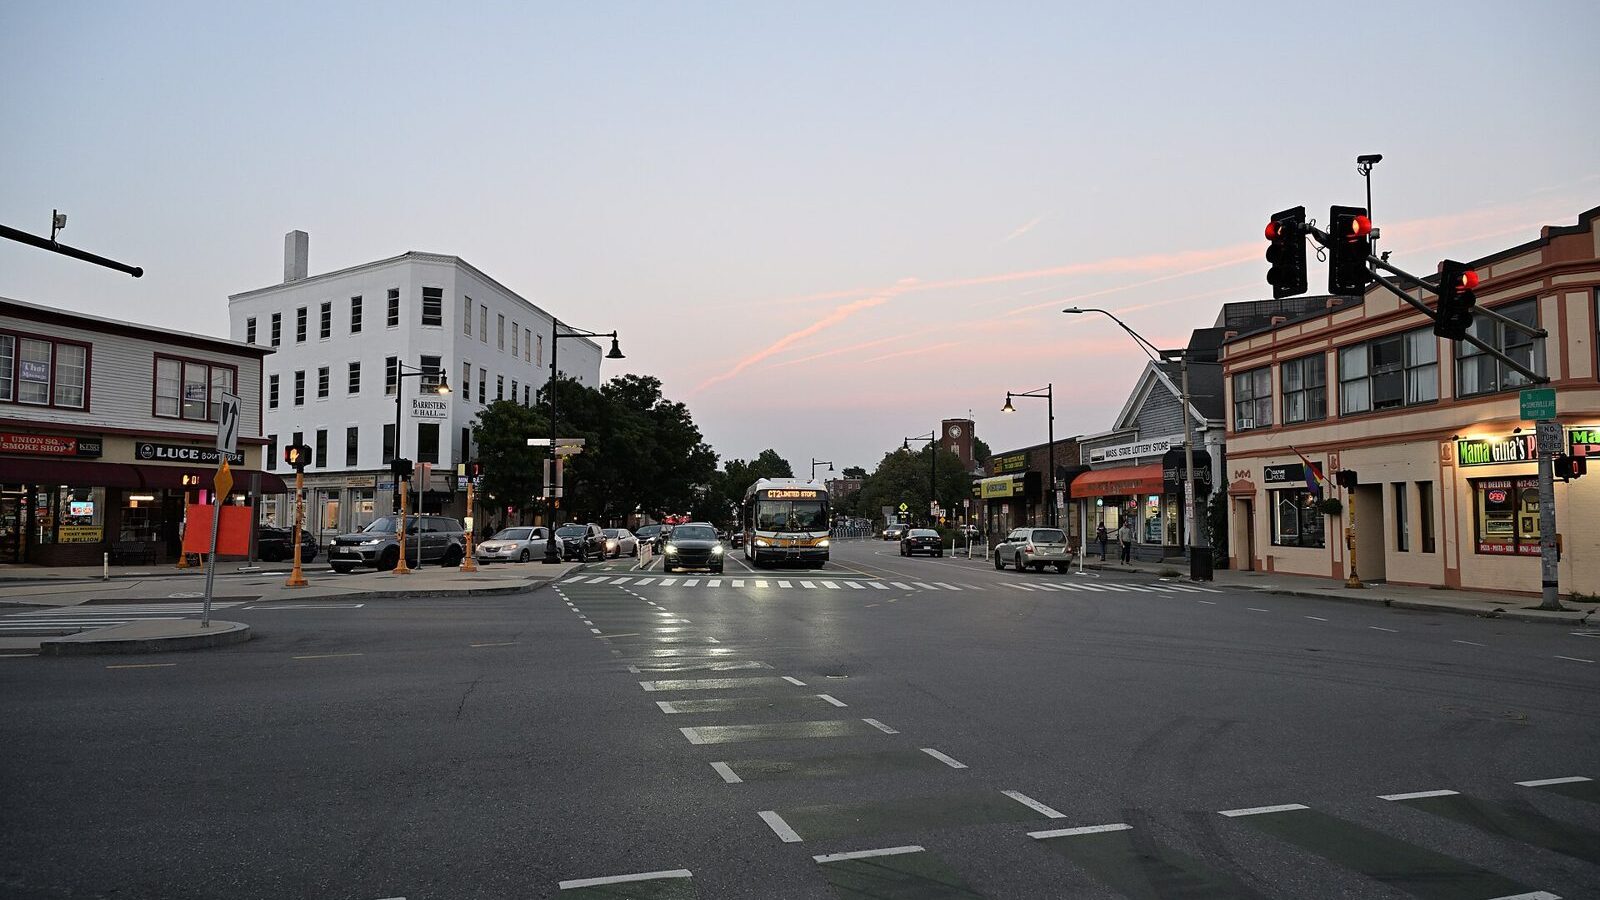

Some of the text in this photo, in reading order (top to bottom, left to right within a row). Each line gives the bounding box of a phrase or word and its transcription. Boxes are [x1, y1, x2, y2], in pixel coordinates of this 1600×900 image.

[412, 399, 447, 409] BARRISTERS
[11, 436, 43, 444] UNION
[2, 442, 66, 452] SMOKE SHOP
[1118, 446, 1131, 456] STATE
[1132, 444, 1152, 454] LOTTERY
[1152, 441, 1169, 452] STORE
[1460, 440, 1490, 464] Mama
[1492, 436, 1525, 462] Gina's
[156, 447, 243, 462] LUCE BOUTQUE
[1478, 481, 1487, 489] WE
[1488, 480, 1512, 488] DELIVER
[767, 490, 781, 498] CT2
[781, 490, 800, 498] LIMITED
[1488, 492, 1506, 501] OPEN
